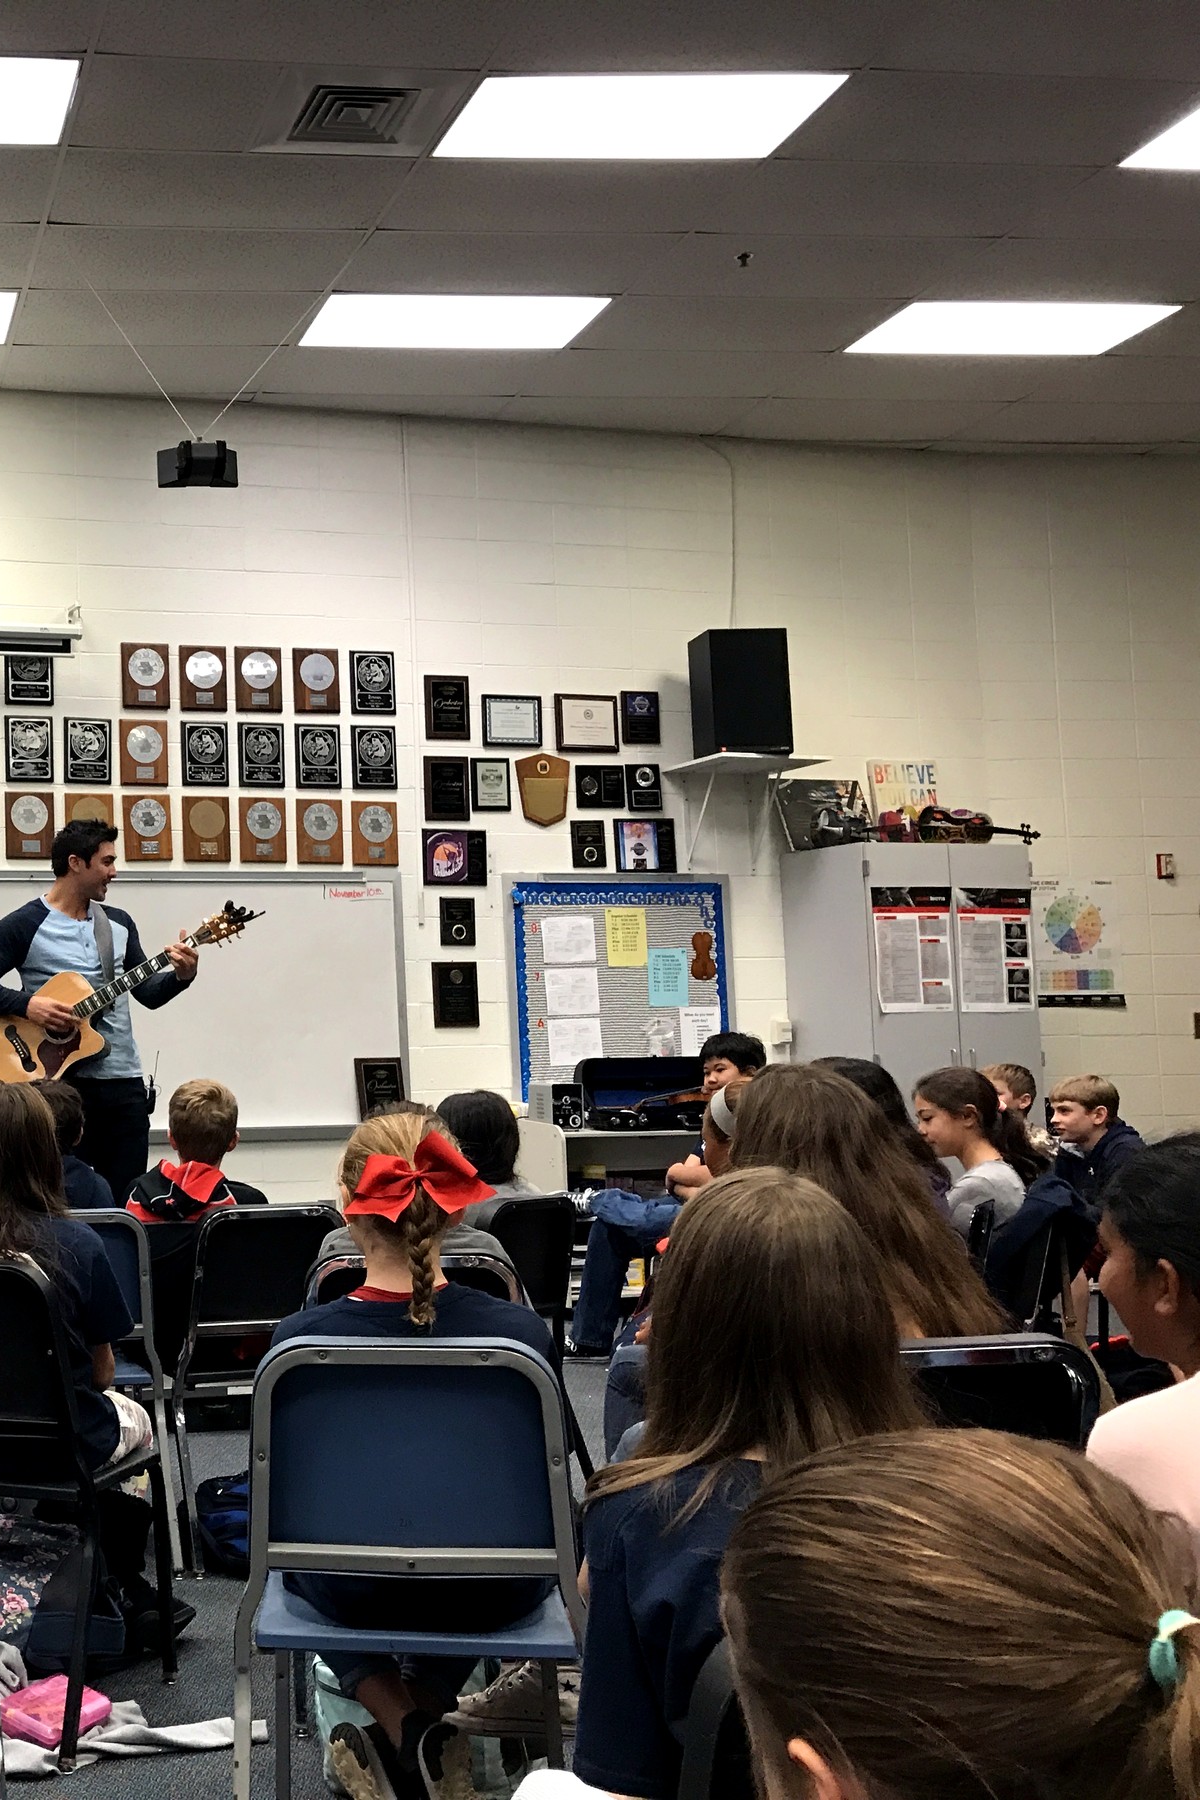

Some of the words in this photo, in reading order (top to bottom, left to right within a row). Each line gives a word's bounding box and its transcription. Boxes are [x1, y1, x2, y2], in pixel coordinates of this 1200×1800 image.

[874, 764, 936, 784] BELIEVE
[910, 788, 937, 806] CAN
[329, 888, 365, 898] November
[530, 922, 537, 934] 8
[535, 973, 540, 981] 7
[538, 1018, 544, 1028] 6
